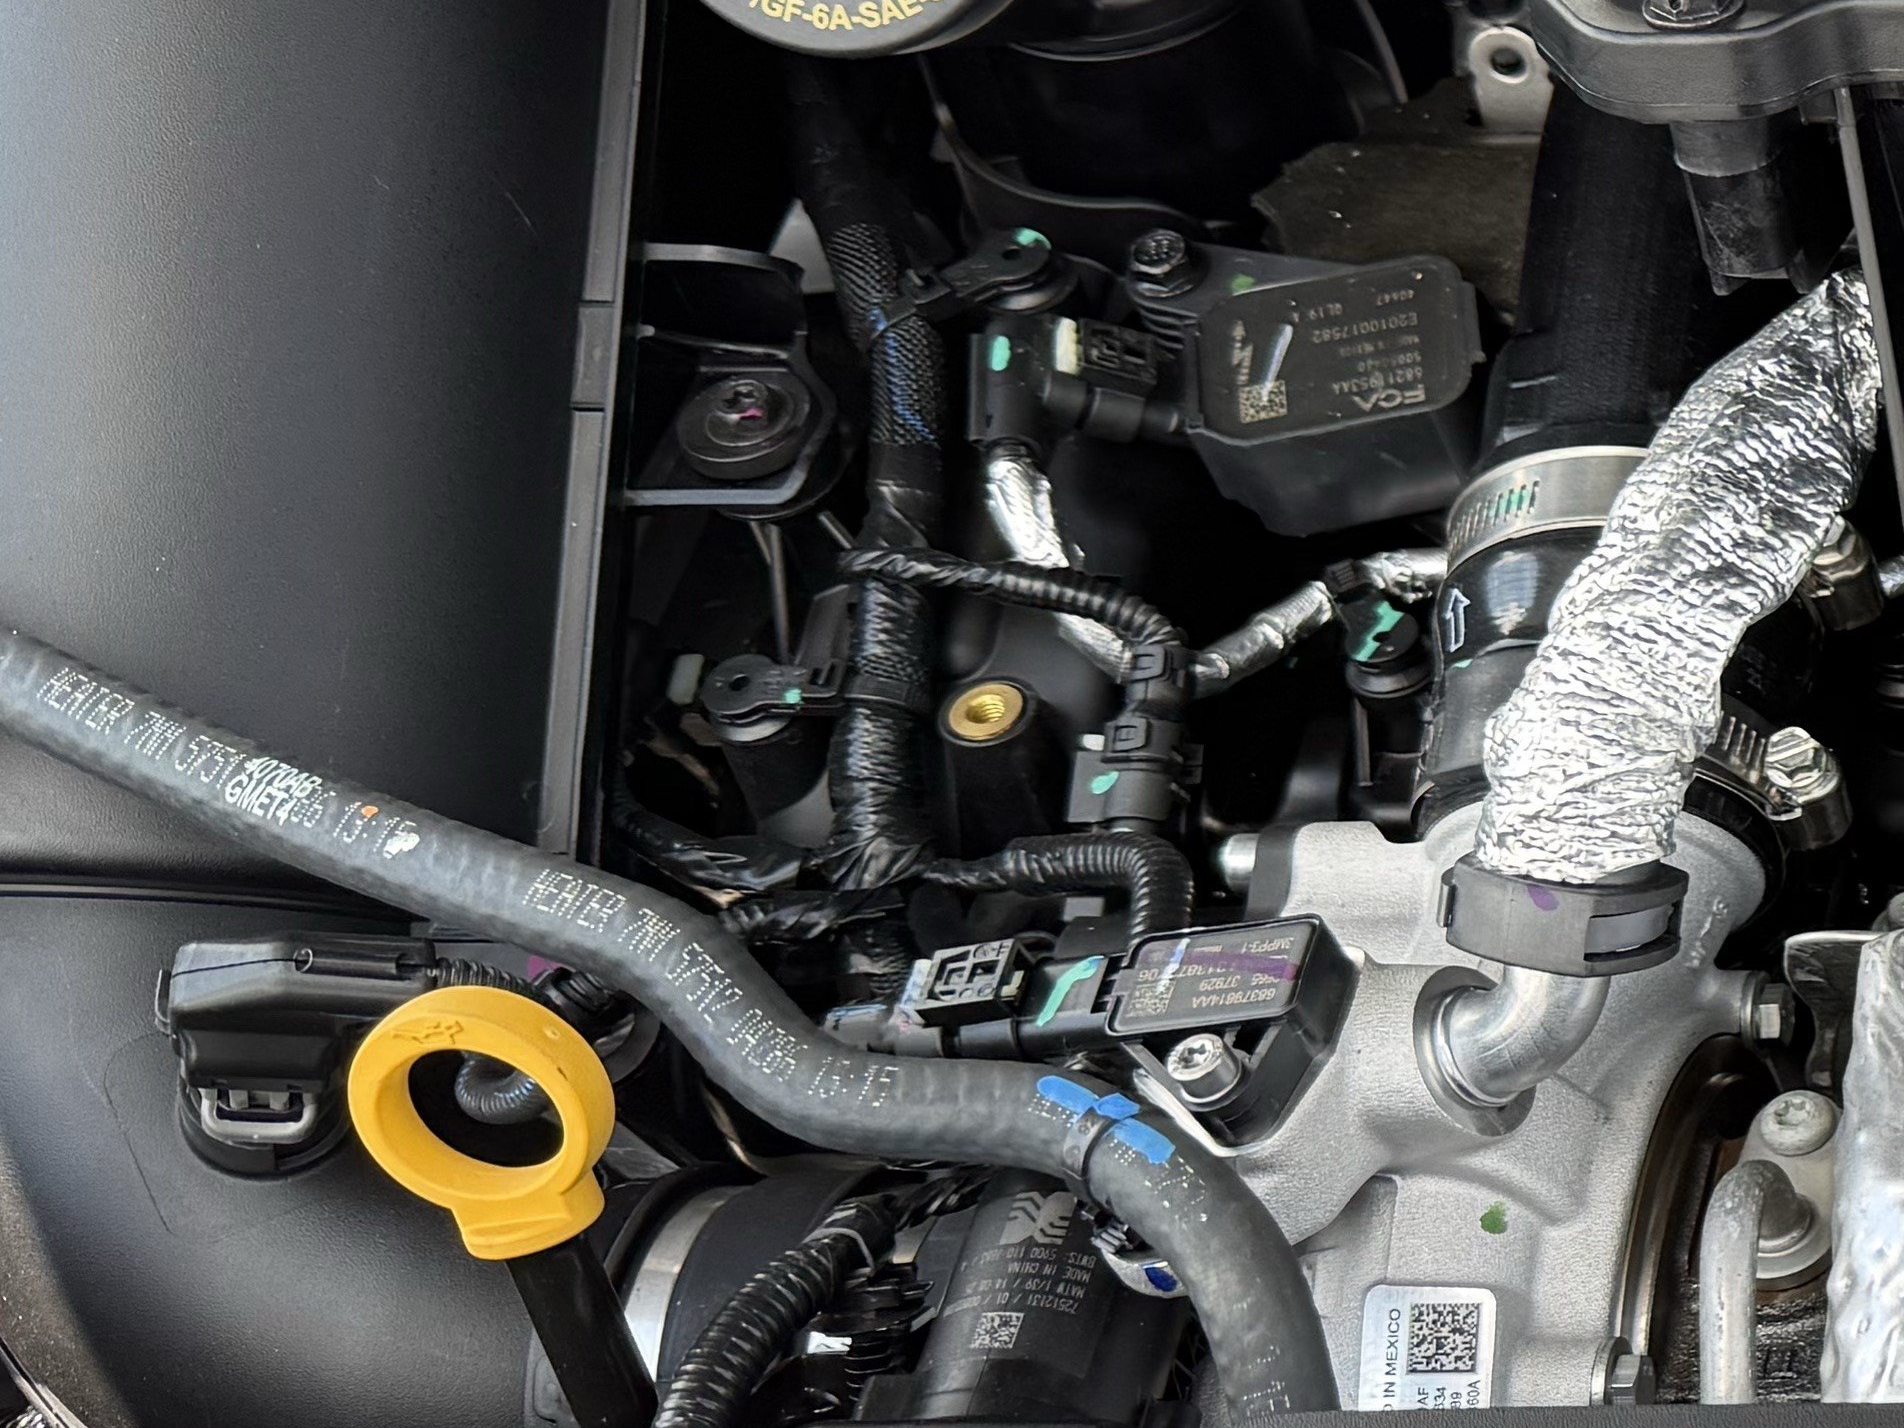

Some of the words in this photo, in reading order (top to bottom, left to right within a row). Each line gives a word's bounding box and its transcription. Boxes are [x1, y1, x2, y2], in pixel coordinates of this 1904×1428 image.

[1351, 383, 1426, 412] FCA
[37, 666, 135, 737] HEATER
[175, 733, 243, 804] 5751
[524, 867, 627, 936] HEATER
[1007, 1261, 1040, 1274] CHINA
[1043, 1264, 1058, 1276] IN
[1061, 1267, 1092, 1283] MADE
[1384, 1308, 1402, 1376] MEXICO
[1383, 1382, 1396, 1398] IN
